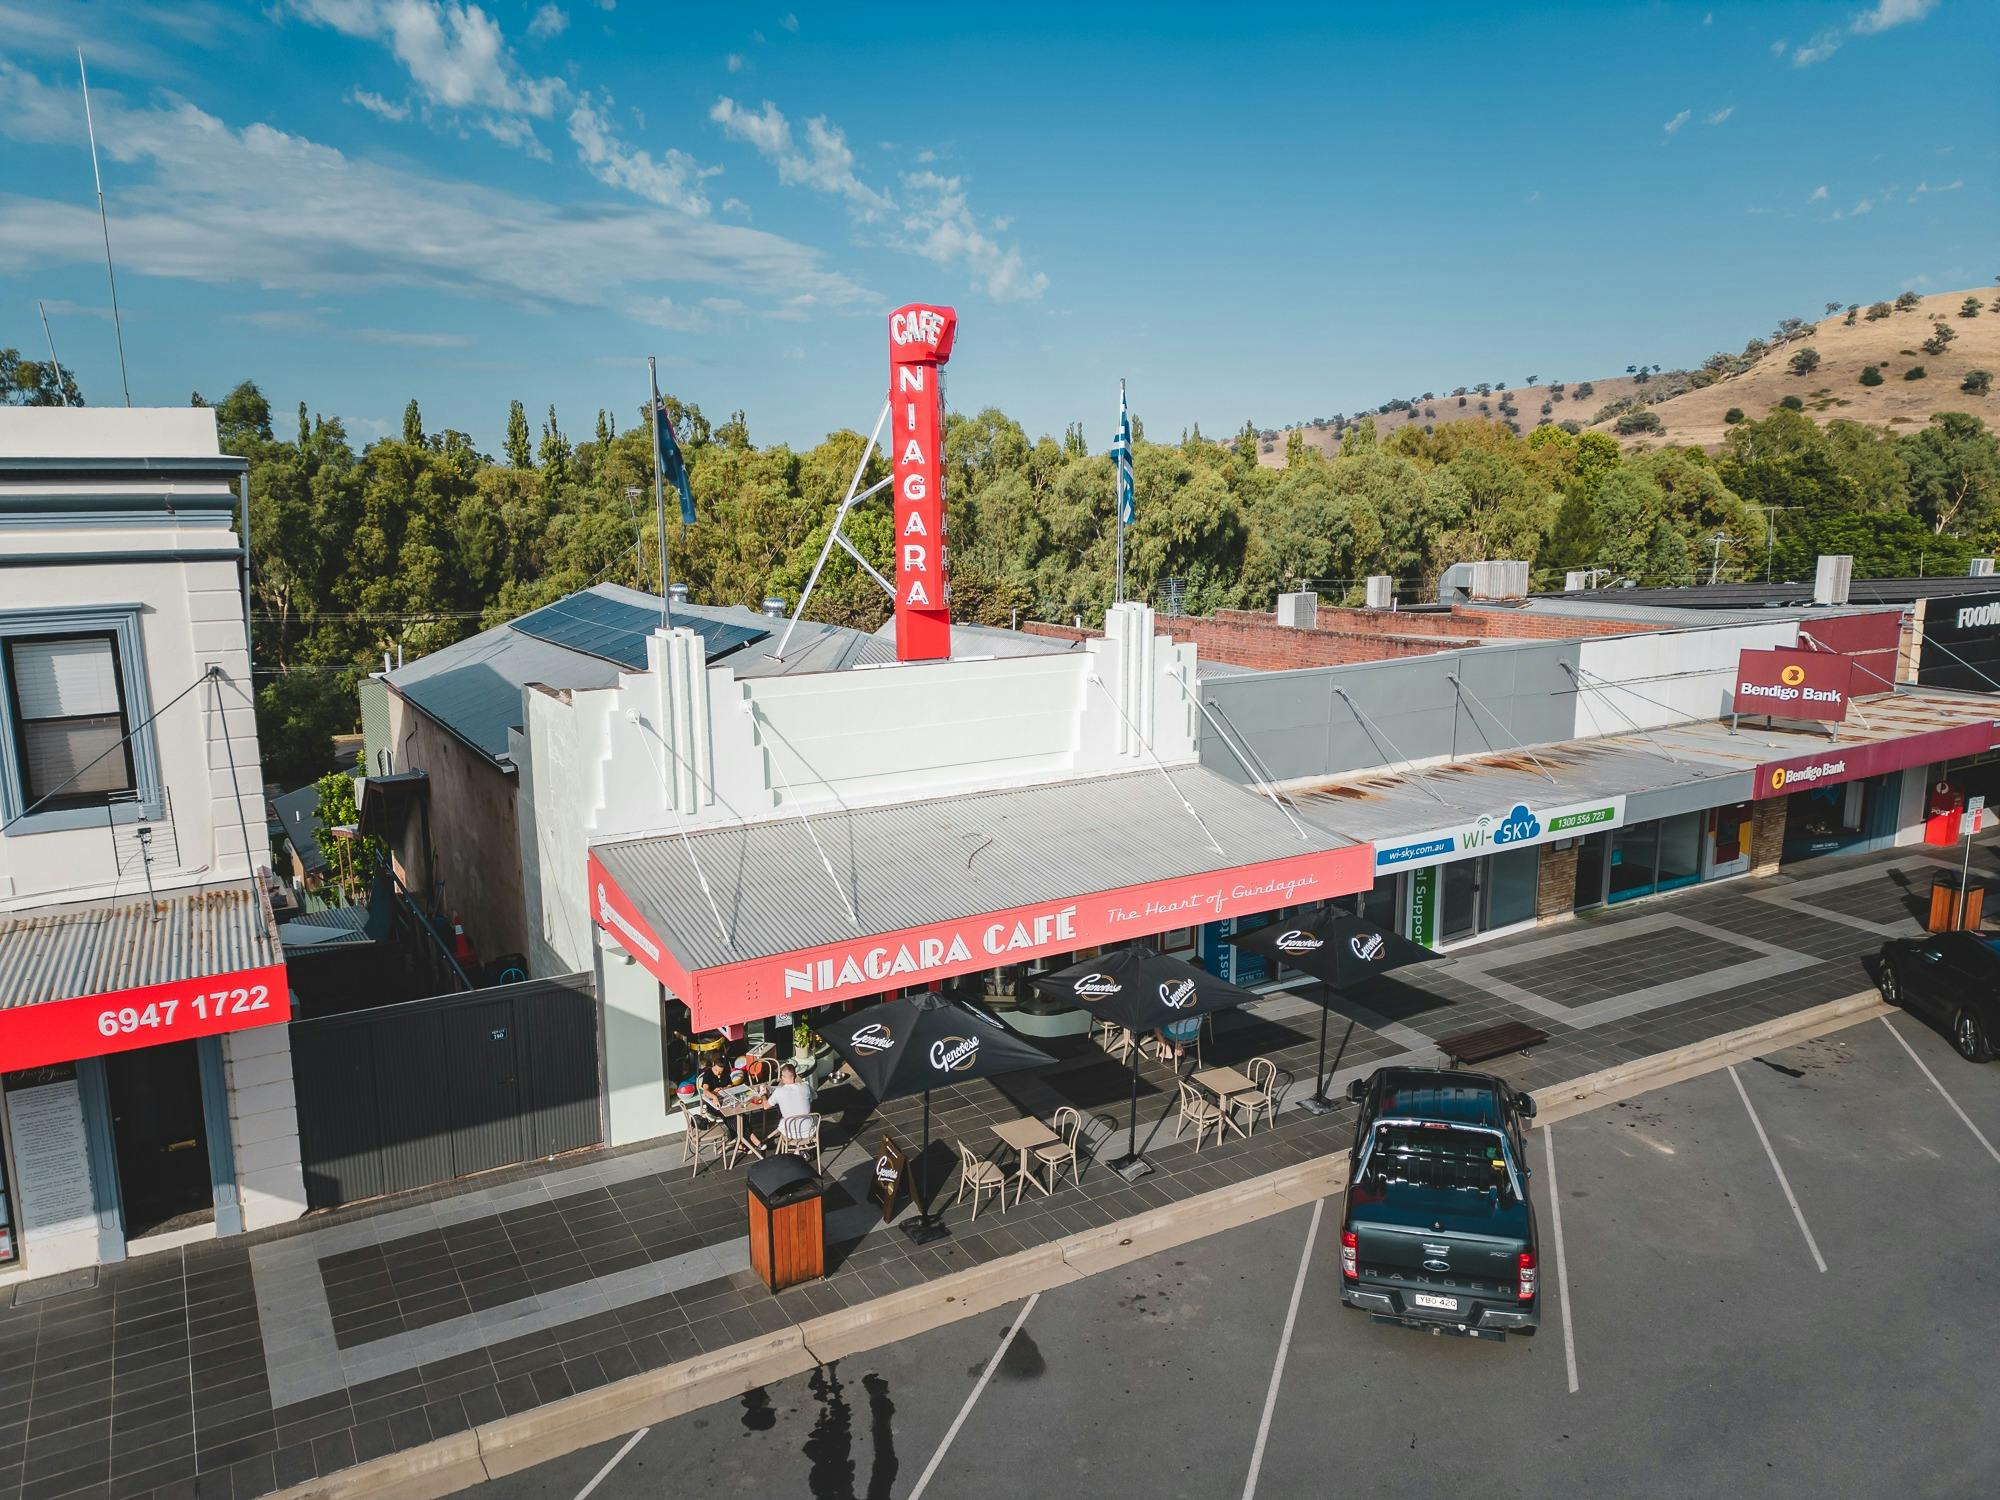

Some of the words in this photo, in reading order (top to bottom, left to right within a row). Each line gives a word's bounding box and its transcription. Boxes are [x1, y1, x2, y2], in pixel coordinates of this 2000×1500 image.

[891, 310, 944, 346] CAFE
[899, 366, 929, 605] NIAGARA
[1741, 682, 1799, 700] Bendigo
[1802, 687, 1841, 702] Bank
[1785, 766, 1821, 783] Bendigo
[1822, 760, 1845, 776] Bank
[1389, 842, 1445, 860] wi-sky.com.au
[1558, 817, 1575, 829] 1300
[1576, 814, 1591, 826] 556
[1592, 811, 1605, 822] 723
[1107, 908, 1141, 923] The
[1145, 894, 1204, 916] Heart
[1206, 889, 1229, 914] of
[1232, 874, 1318, 899] Gundagai
[784, 932, 973, 999] NIAGARA
[983, 905, 1077, 955] CAFÉ
[1276, 930, 1324, 949] Genovese
[1351, 933, 1384, 962] Genovese
[1219, 954, 1229, 978] ast
[1073, 973, 1122, 995] Genovese
[1159, 978, 1196, 1009] Genovese
[97, 1000, 179, 1037] 6947
[192, 985, 270, 1019] 1722
[850, 1023, 895, 1050] Genovese
[929, 1036, 980, 1072] Genovese
[1365, 1268, 1511, 1294] RANGER
